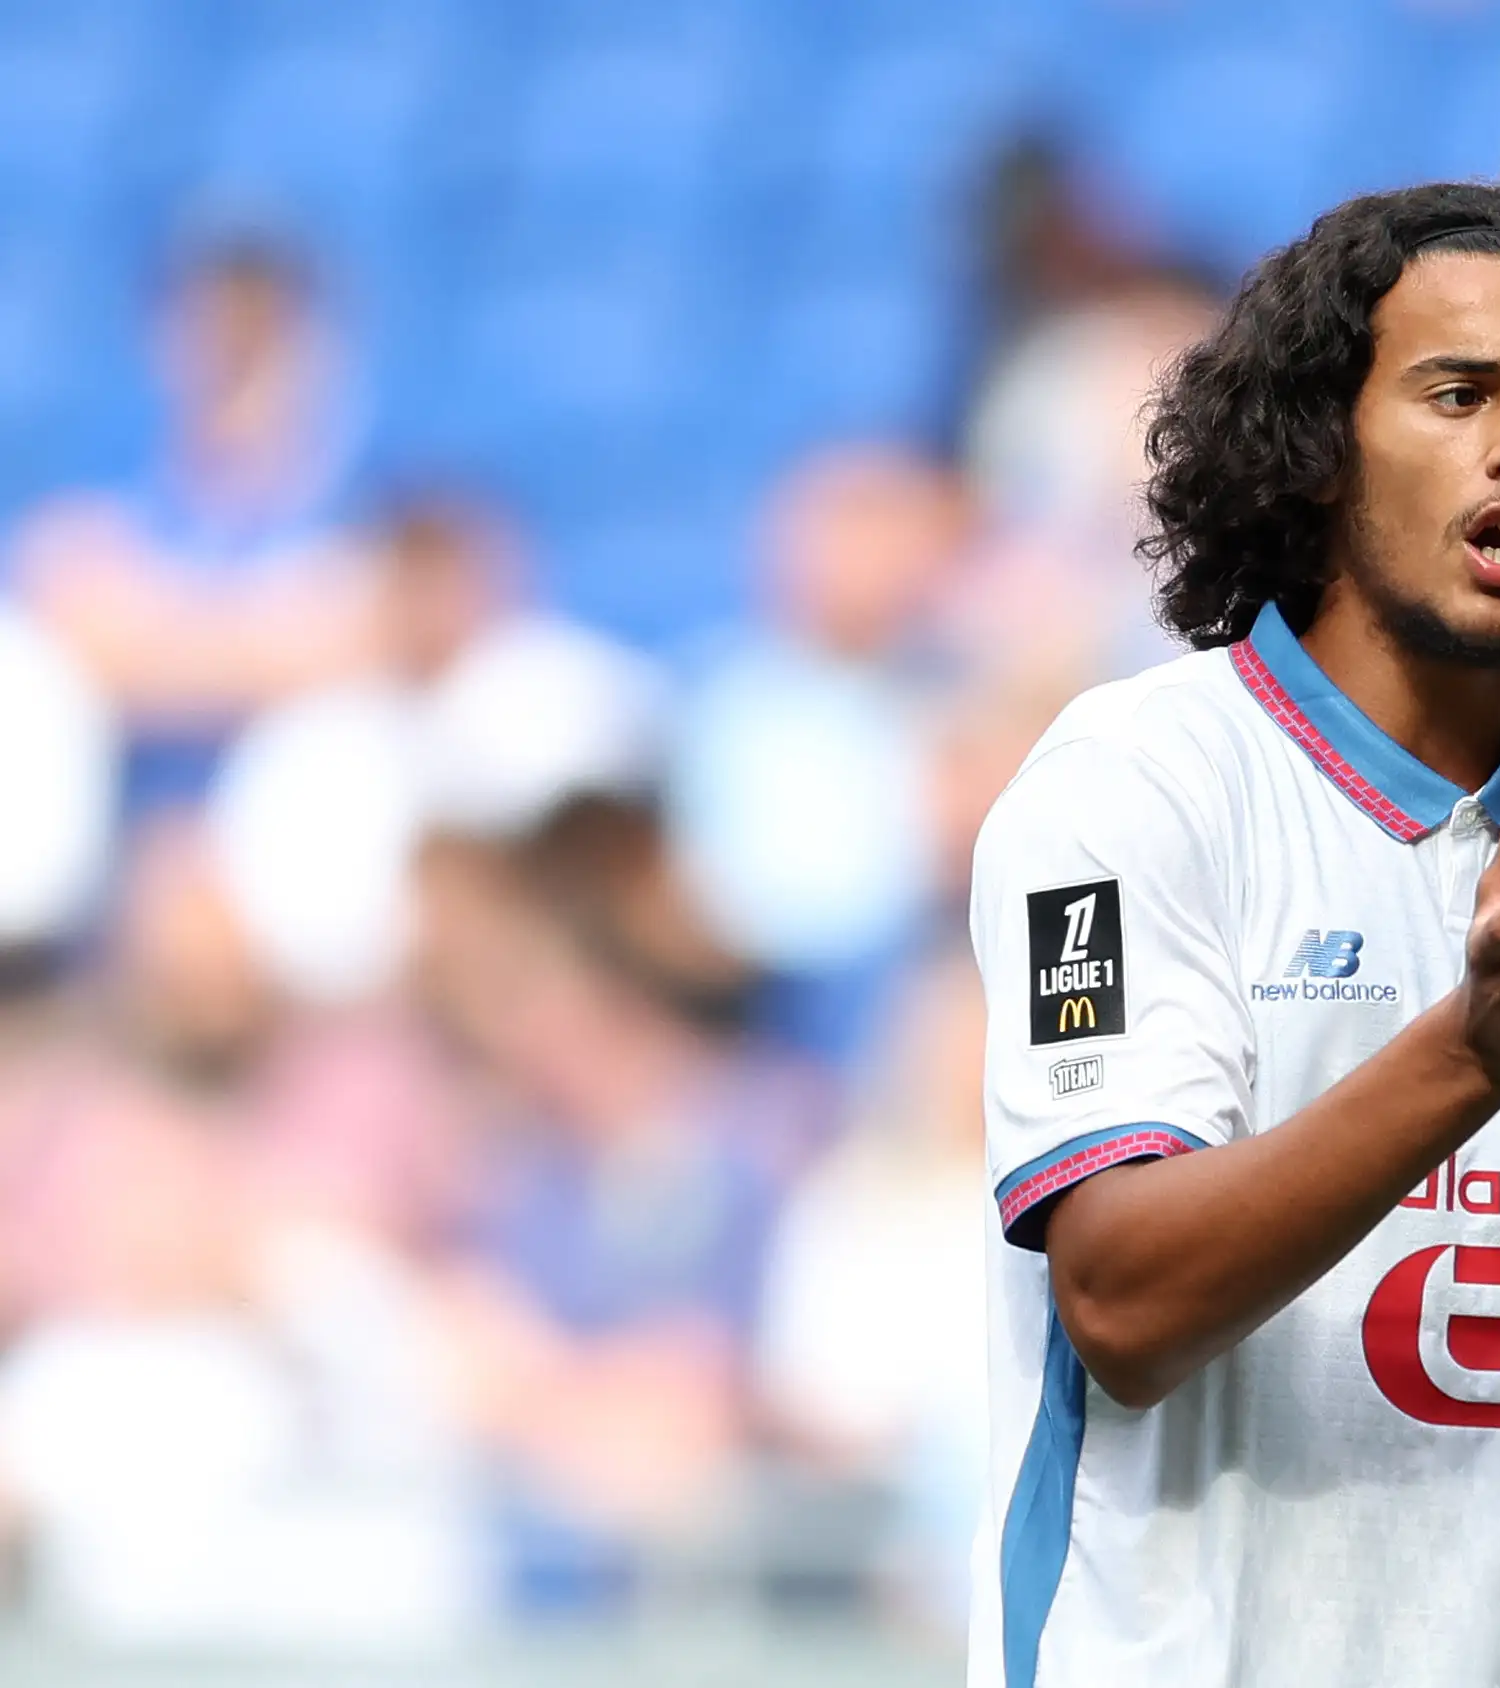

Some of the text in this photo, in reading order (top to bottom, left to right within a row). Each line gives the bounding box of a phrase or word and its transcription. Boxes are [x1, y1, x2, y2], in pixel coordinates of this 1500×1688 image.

[1283, 929, 1364, 978] NB
[1251, 979, 1397, 1001] new balance
